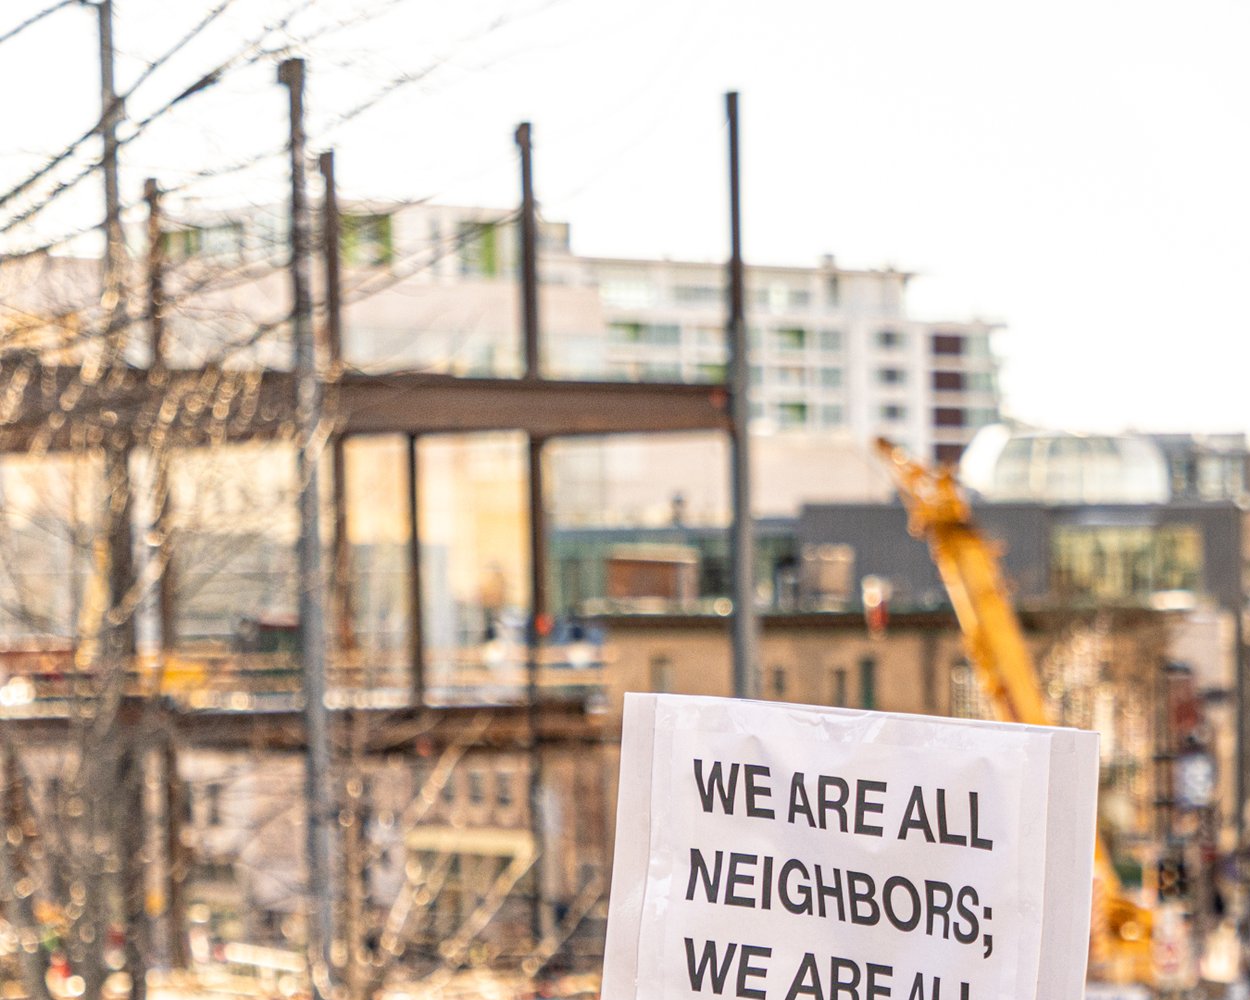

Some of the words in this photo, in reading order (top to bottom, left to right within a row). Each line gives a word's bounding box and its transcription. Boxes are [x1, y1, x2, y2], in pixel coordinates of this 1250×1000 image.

[693, 758, 776, 820] WE
[787, 771, 888, 838] ARE
[897, 785, 994, 851] ALL
[685, 847, 994, 960] NEIGHBORS;
[684, 937, 773, 1000] WE
